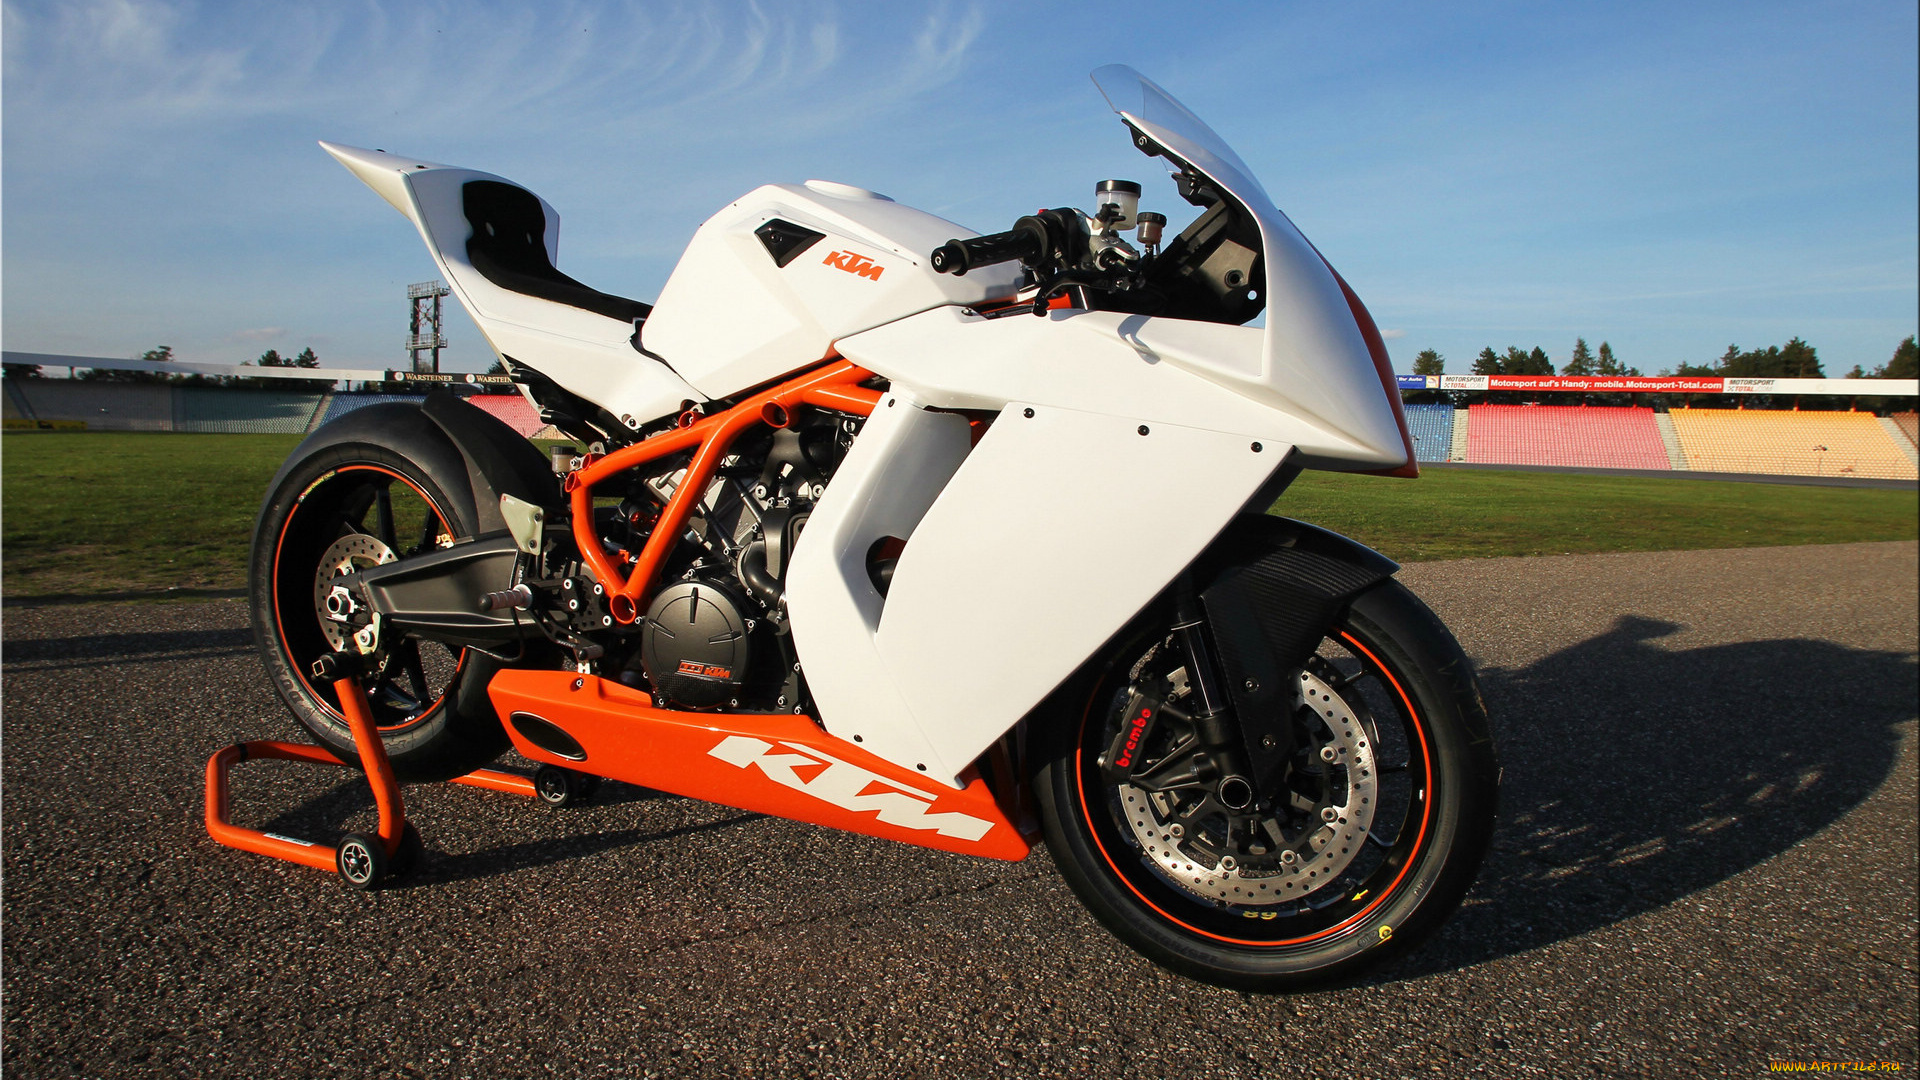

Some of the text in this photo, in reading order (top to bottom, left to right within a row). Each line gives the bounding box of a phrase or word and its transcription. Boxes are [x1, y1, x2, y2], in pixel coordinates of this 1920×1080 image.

[822, 250, 885, 281] KTM
[405, 373, 453, 382] WARSTEINER
[1491, 379, 1537, 388] Motorsport
[1561, 380, 1592, 389] Handy:
[1594, 380, 1722, 390] mobile.Motorsport-Total.com
[703, 666, 731, 678] KTM
[1115, 708, 1151, 767] brembo
[707, 735, 995, 841] KTM
